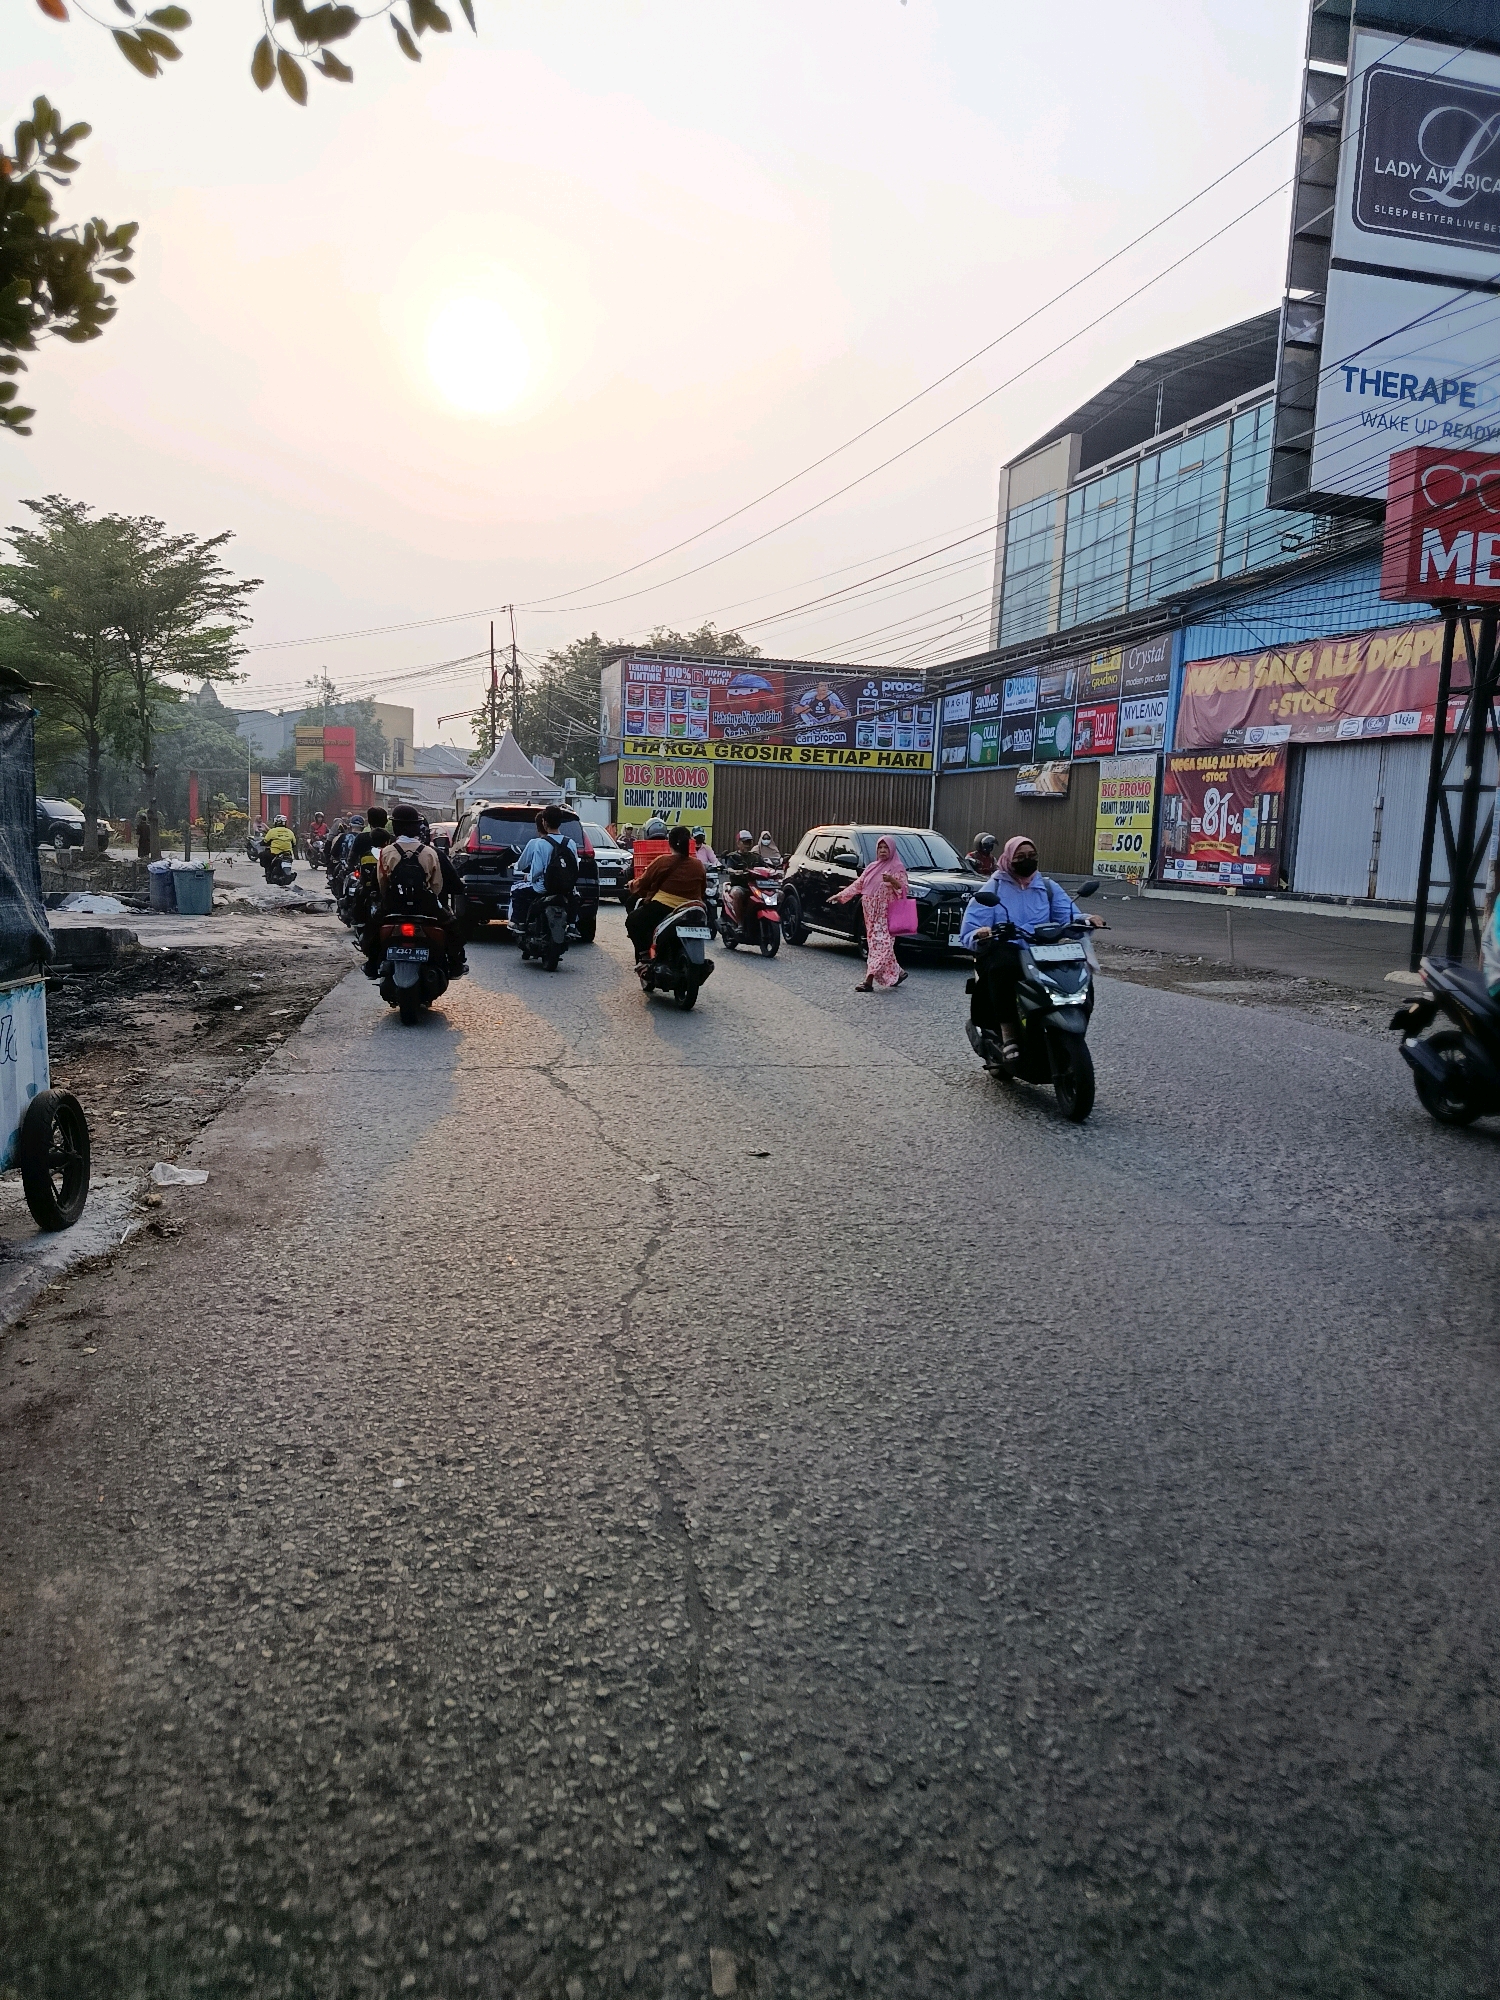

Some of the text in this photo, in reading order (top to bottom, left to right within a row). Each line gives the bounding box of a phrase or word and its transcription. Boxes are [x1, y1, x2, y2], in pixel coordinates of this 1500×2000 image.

[1374, 157, 1422, 180] LADY
[1374, 204, 1409, 218] SLEEP
[1411, 210, 1454, 226] BETTER
[1456, 218, 1481, 230] LIVE
[1361, 411, 1409, 432] WAKE
[1415, 417, 1438, 435] UP
[1129, 638, 1168, 673] Crystal
[1315, 641, 1364, 680] ALL
[629, 671, 662, 682] TINTING
[663, 666, 692, 680] 100%
[704, 669, 732, 679] NIPPON
[708, 677, 729, 686] PAINT
[765, 710, 782, 724] Paint
[632, 739, 925, 768] HARGA GROSIR SETIAP HARI
[1219, 754, 1236, 769] ALL
[1237, 751, 1277, 768] DISPLAY
[623, 764, 709, 787] BIG PROMO
[1101, 780, 1152, 797] BIG PROMO
[624, 788, 708, 809] GRANITE CREAM POLOS
[651, 809, 671, 822] KW
[1115, 815, 1133, 826] KW 1
